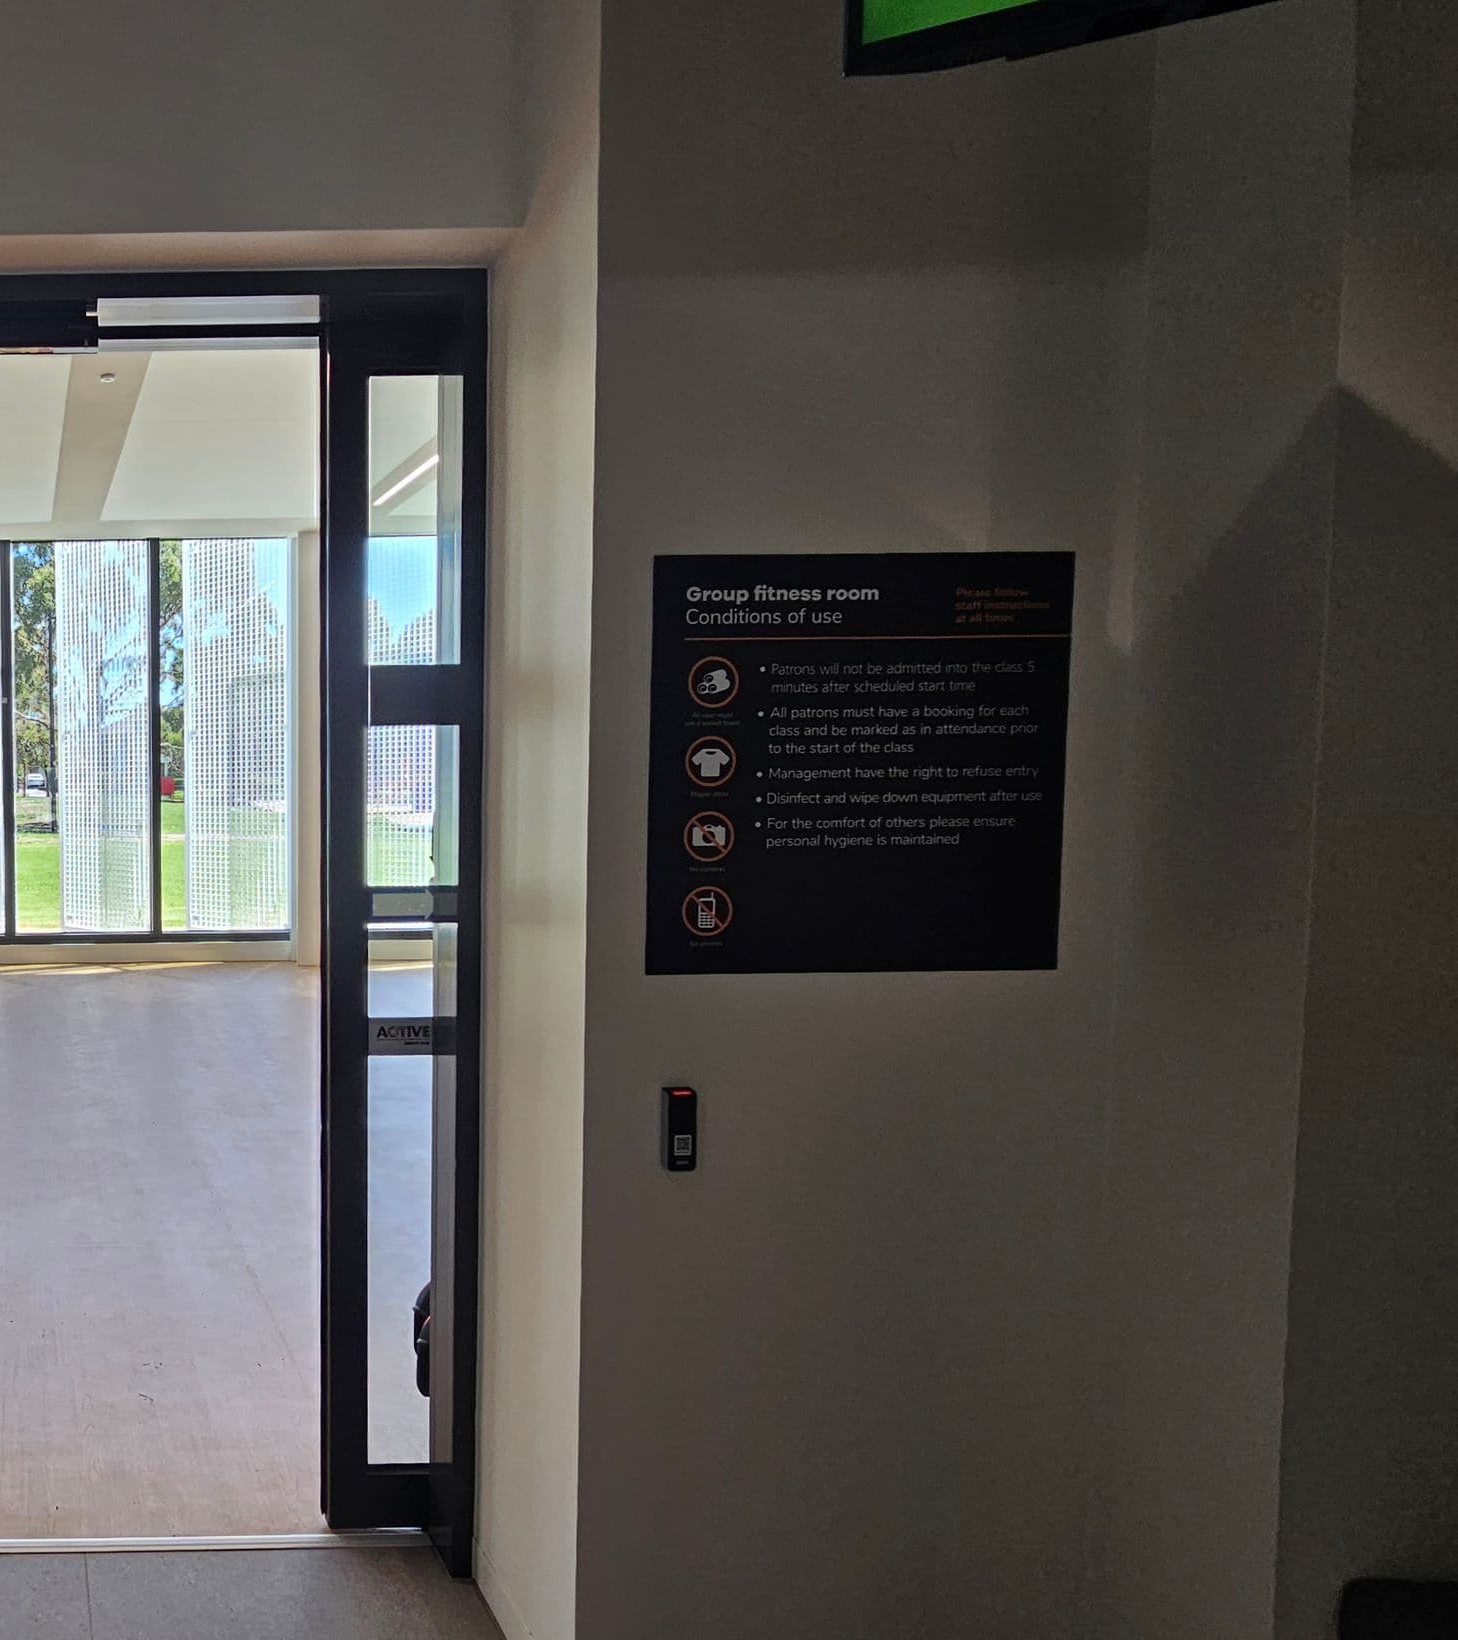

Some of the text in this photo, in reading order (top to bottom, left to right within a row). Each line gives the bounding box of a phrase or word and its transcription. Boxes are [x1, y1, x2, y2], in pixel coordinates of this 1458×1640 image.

[686, 585, 879, 604] Group fitness room
[686, 608, 842, 625] Conditions of use
[771, 663, 815, 675] Patrons
[820, 663, 840, 674] will
[843, 664, 862, 674] not
[866, 663, 882, 674] be
[887, 662, 941, 674] admitted
[945, 662, 967, 673] into
[972, 661, 991, 673] the
[995, 661, 1023, 673] class
[772, 679, 976, 693] minutes after scheduled start time
[770, 704, 1029, 721] All patrons must have a booking for each
[769, 723, 1038, 737] class and be marked as in attendance prior
[769, 741, 914, 754] to the start of the class
[769, 765, 1039, 782] Management have the right to refuse entry
[766, 790, 1042, 806] Disinfect and wipe down equipment after use
[767, 816, 1016, 830] For the comfort of others please ensure
[766, 833, 959, 850] personal hygiene is maintained
[376, 1025, 430, 1039] ACTIVE
